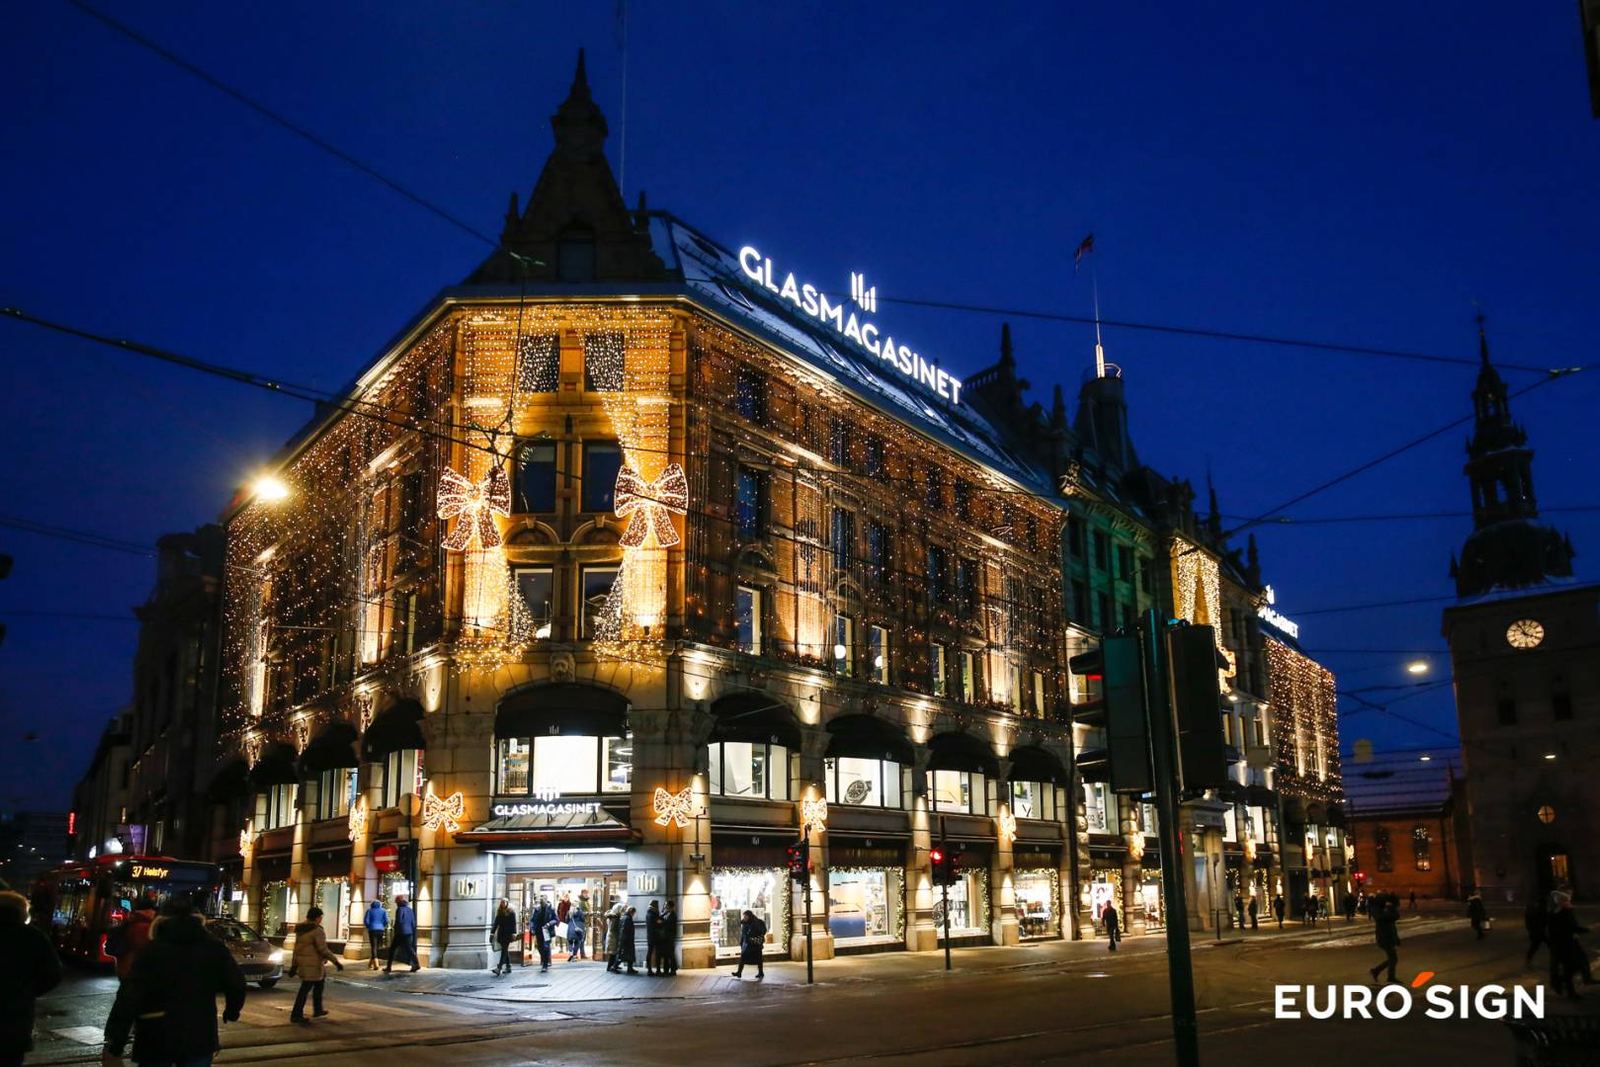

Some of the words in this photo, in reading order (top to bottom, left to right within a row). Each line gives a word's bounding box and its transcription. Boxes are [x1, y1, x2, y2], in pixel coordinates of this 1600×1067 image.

[739, 246, 962, 404] GLASMAGASINET
[494, 803, 601, 816] GLASMAGASINET
[131, 866, 143, 878] 37
